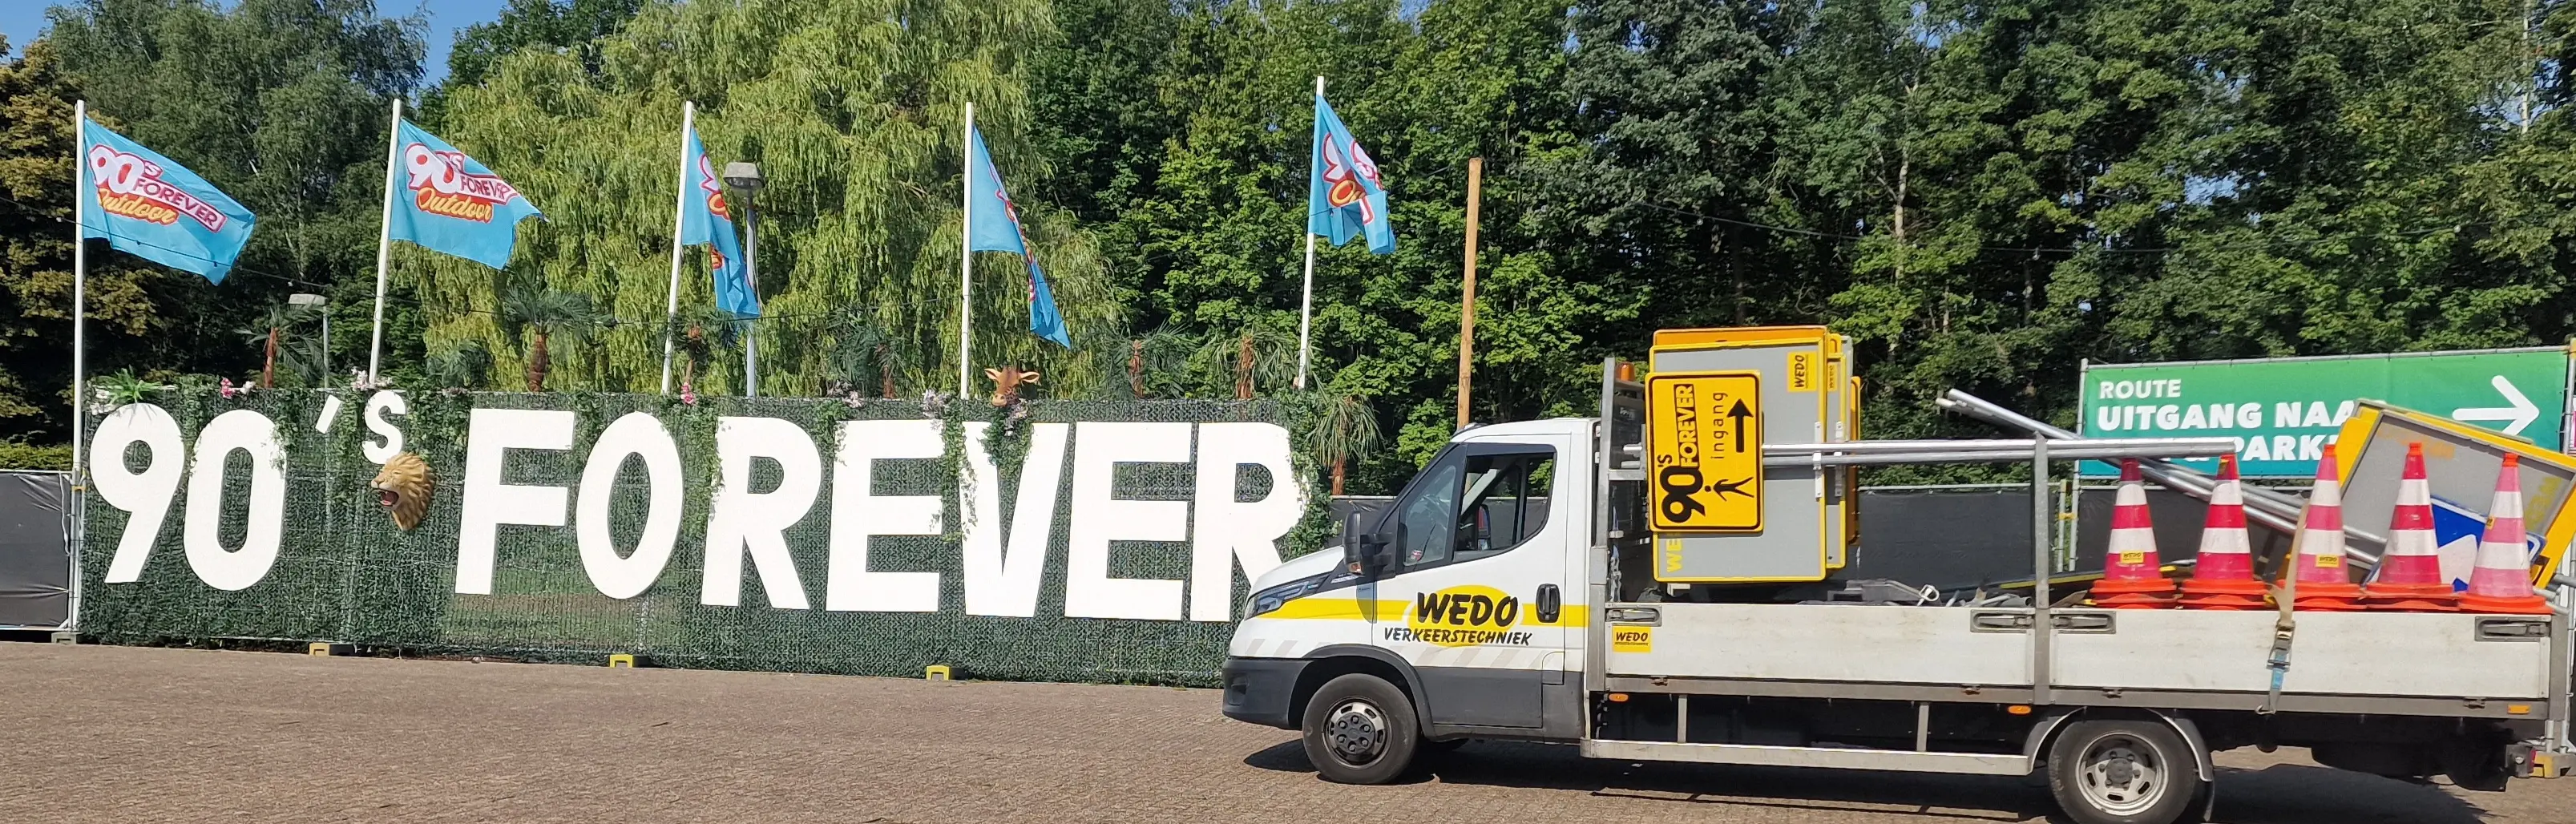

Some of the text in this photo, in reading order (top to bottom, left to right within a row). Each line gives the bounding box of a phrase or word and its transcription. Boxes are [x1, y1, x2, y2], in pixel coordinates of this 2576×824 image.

[133, 178, 218, 227] FOREVER
[418, 187, 493, 224] Outdoor
[1794, 354, 1805, 388] WEDO
[2100, 378, 2182, 399] ROUTE
[1675, 385, 1699, 467] FOREVER
[1710, 392, 1729, 459] ingang
[2098, 401, 2356, 431] UITGANG NAA
[454, 408, 1308, 623] FOREVER
[1666, 531, 1683, 573] WE
[1417, 592, 1519, 628] WEDO
[1384, 627, 1532, 647] VERKEERSTECHNIEK
[1616, 632, 1649, 642] WEDO
